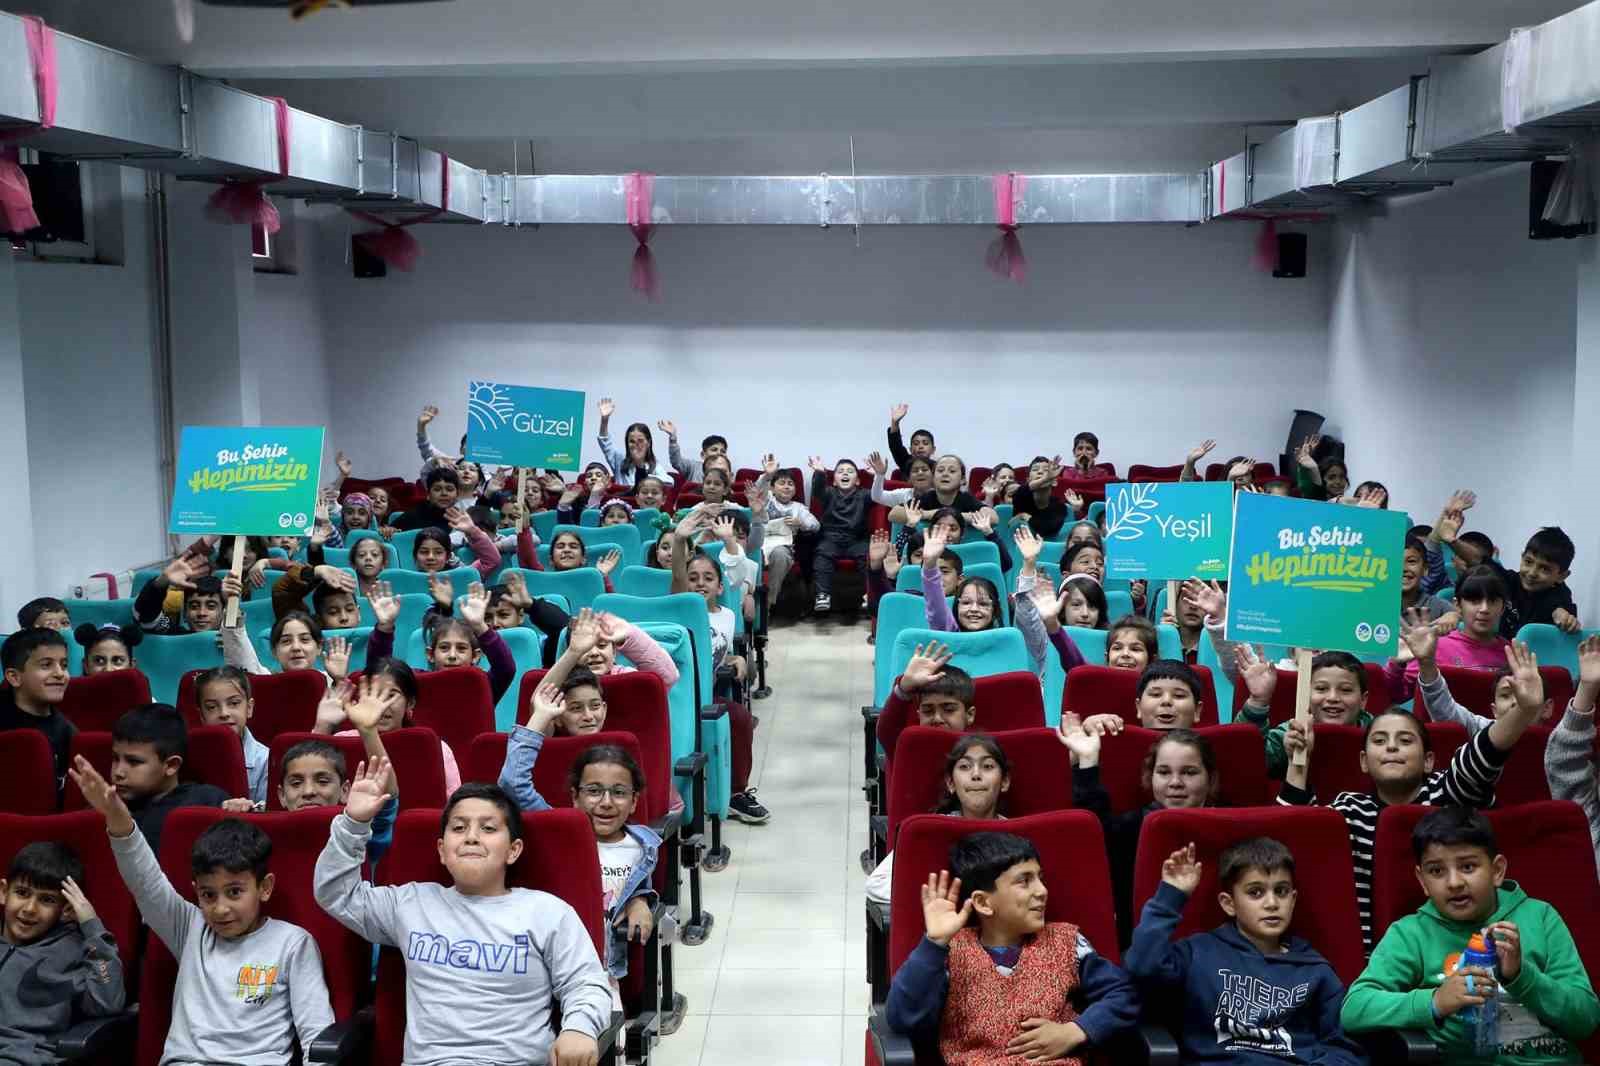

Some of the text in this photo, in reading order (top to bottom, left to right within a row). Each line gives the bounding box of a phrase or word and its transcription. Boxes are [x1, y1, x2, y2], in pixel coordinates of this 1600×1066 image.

[512, 412, 574, 437] Güzel
[216, 443, 289, 466] Bu Şehir
[188, 457, 309, 494] Hepimizin
[1154, 512, 1213, 542] Yeşil
[1278, 525, 1364, 552] Bu Şehir
[1245, 545, 1389, 586] Hepimizin
[407, 931, 529, 974] mavi
[1218, 968, 1309, 1009] THERE
[1215, 990, 1262, 1026] ARE
